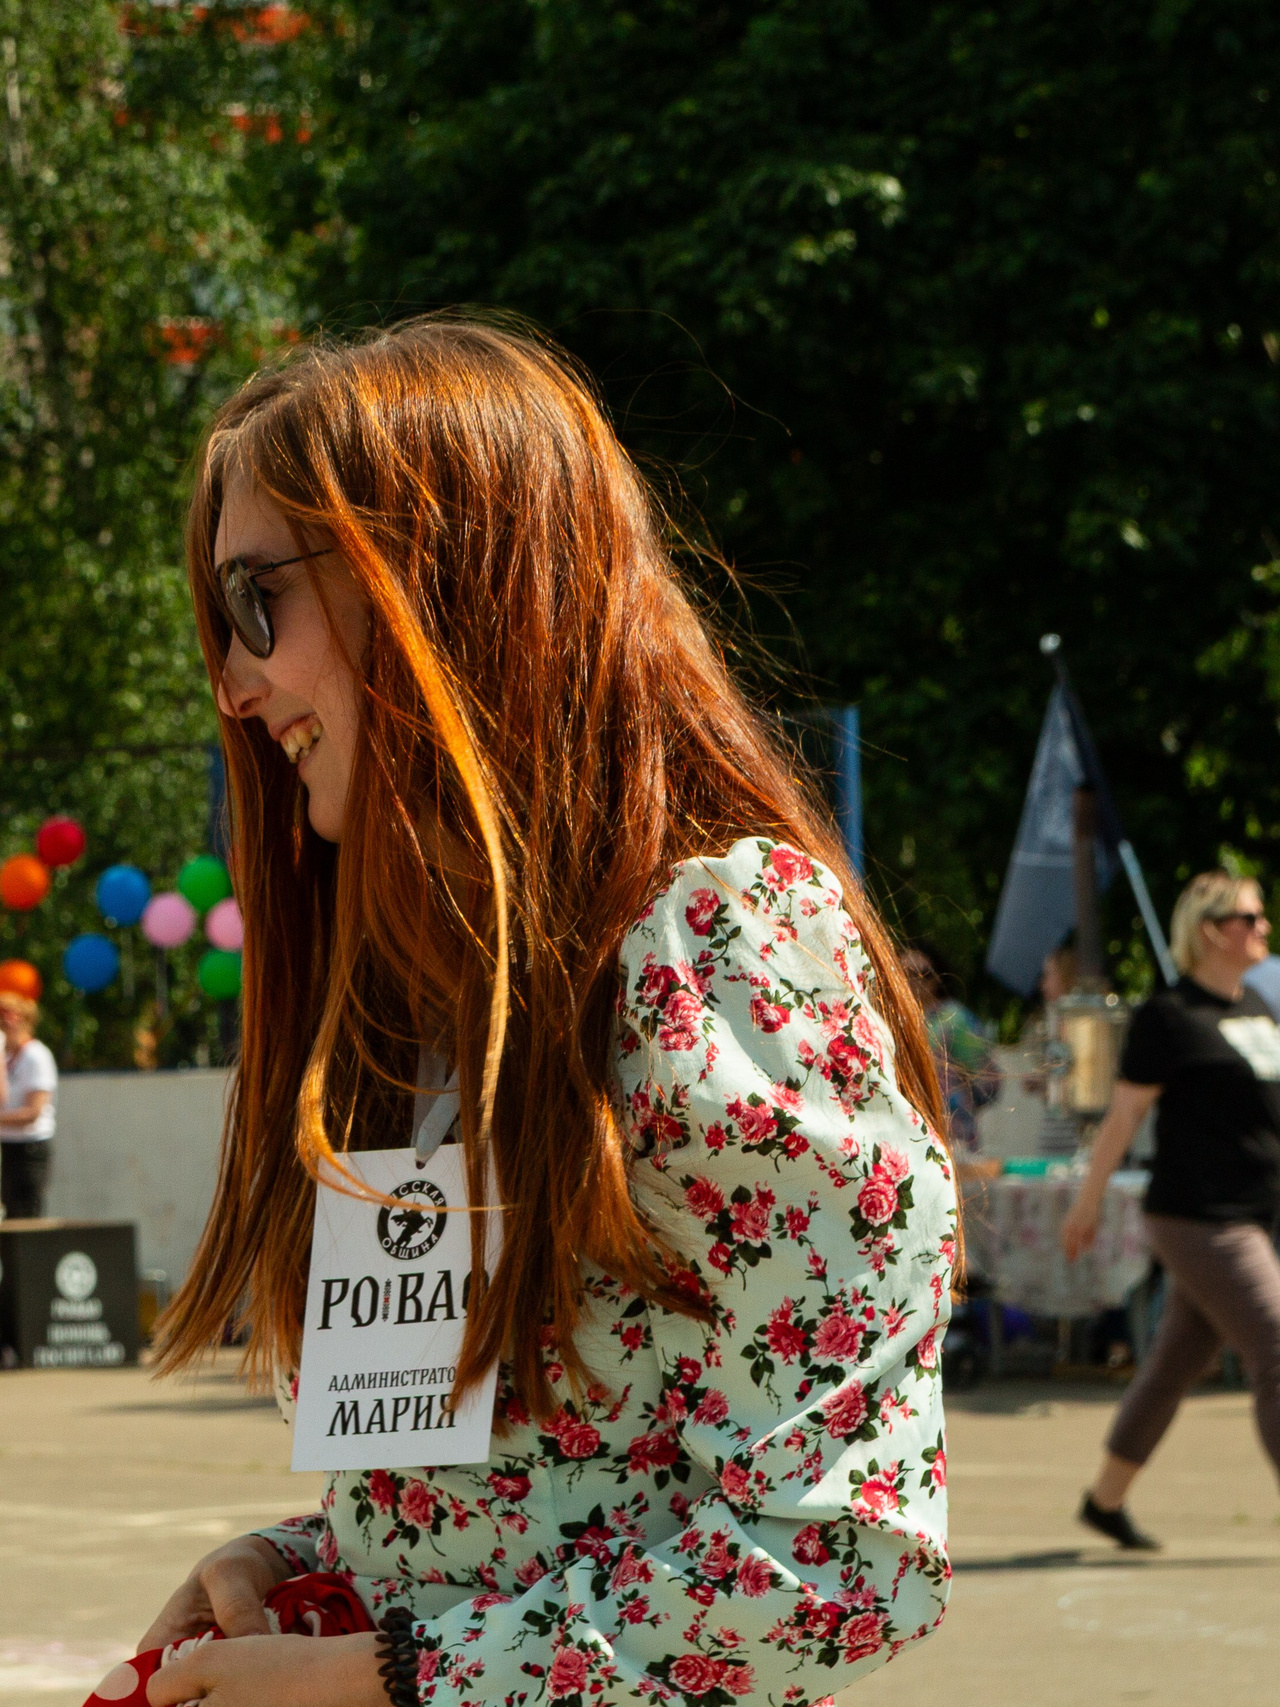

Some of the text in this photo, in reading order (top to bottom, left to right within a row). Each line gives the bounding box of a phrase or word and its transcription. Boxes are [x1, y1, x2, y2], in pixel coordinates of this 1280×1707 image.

[381, 1233, 440, 1259] ОБЩИНА
[327, 1366, 457, 1393] АДМИНИСТРАТО
[325, 1393, 458, 1437] МАРИЯ
